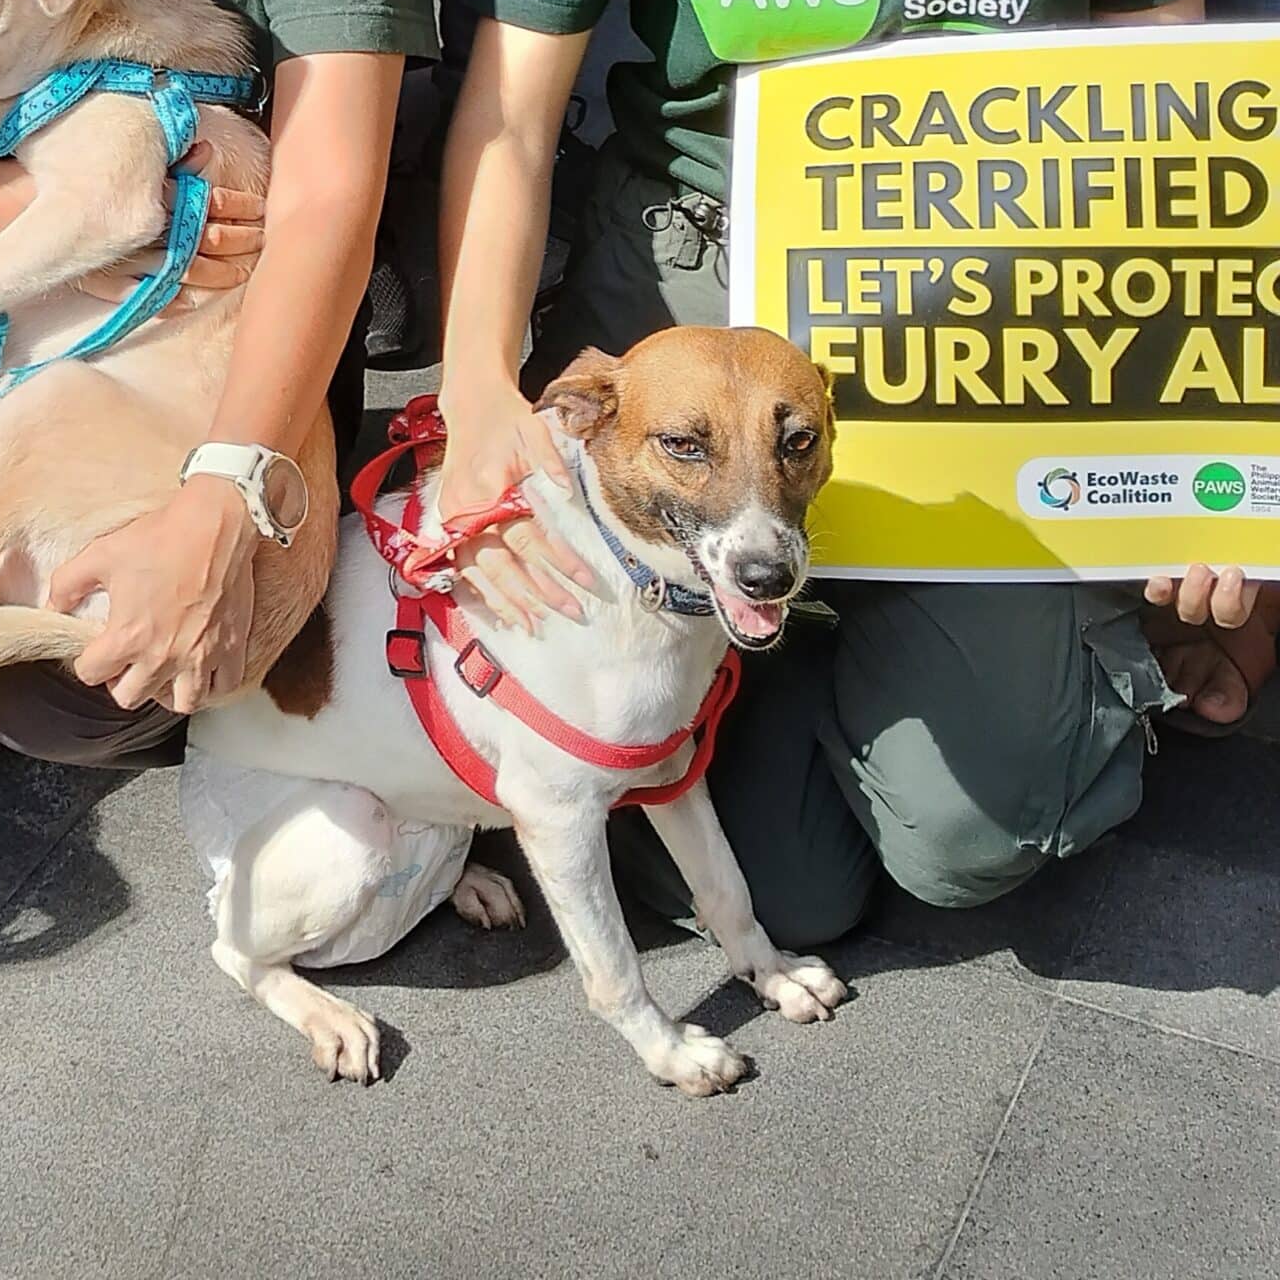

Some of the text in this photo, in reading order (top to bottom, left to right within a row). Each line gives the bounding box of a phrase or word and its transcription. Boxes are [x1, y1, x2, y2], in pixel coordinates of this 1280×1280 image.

[804, 79, 1279, 151] CRACKLING
[805, 156, 1270, 231] TERRIFIED
[809, 326, 1141, 406] FURRY
[1087, 472, 1179, 487] EcoWaste
[1087, 489, 1172, 505] Coalition
[1194, 480, 1244, 494] PAWS
